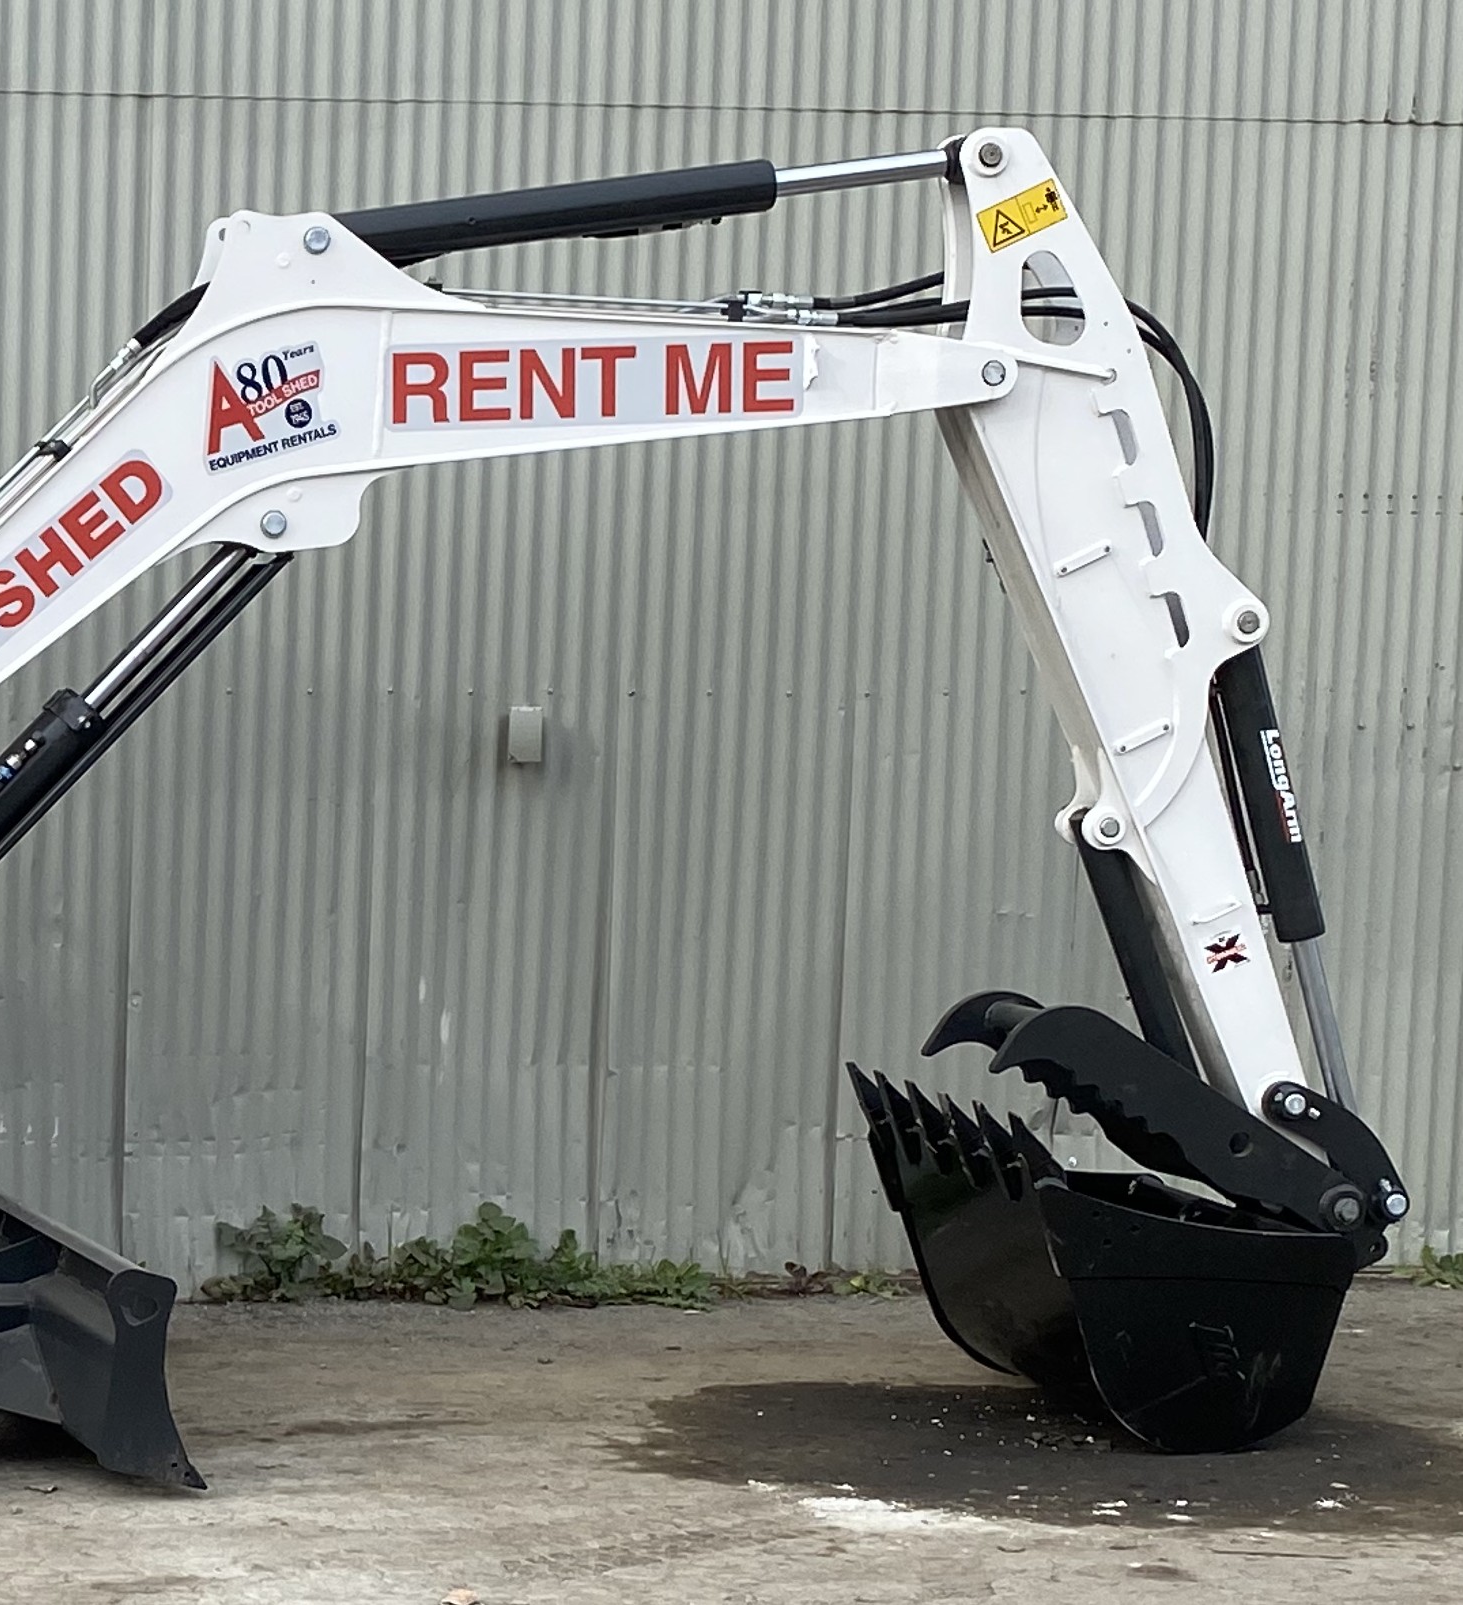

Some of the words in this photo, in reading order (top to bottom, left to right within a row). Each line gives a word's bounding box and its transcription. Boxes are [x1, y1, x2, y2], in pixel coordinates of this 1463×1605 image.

[207, 360, 265, 456] A
[237, 354, 288, 404] 80
[282, 344, 315, 361] Years
[246, 391, 283, 416] TOOL
[281, 374, 318, 398] SHED
[392, 346, 637, 425] RENT
[665, 341, 794, 416] ME
[208, 441, 279, 472] EQUIPMENT
[281, 423, 337, 450] RENTALS
[1260, 728, 1302, 843] LongArm
